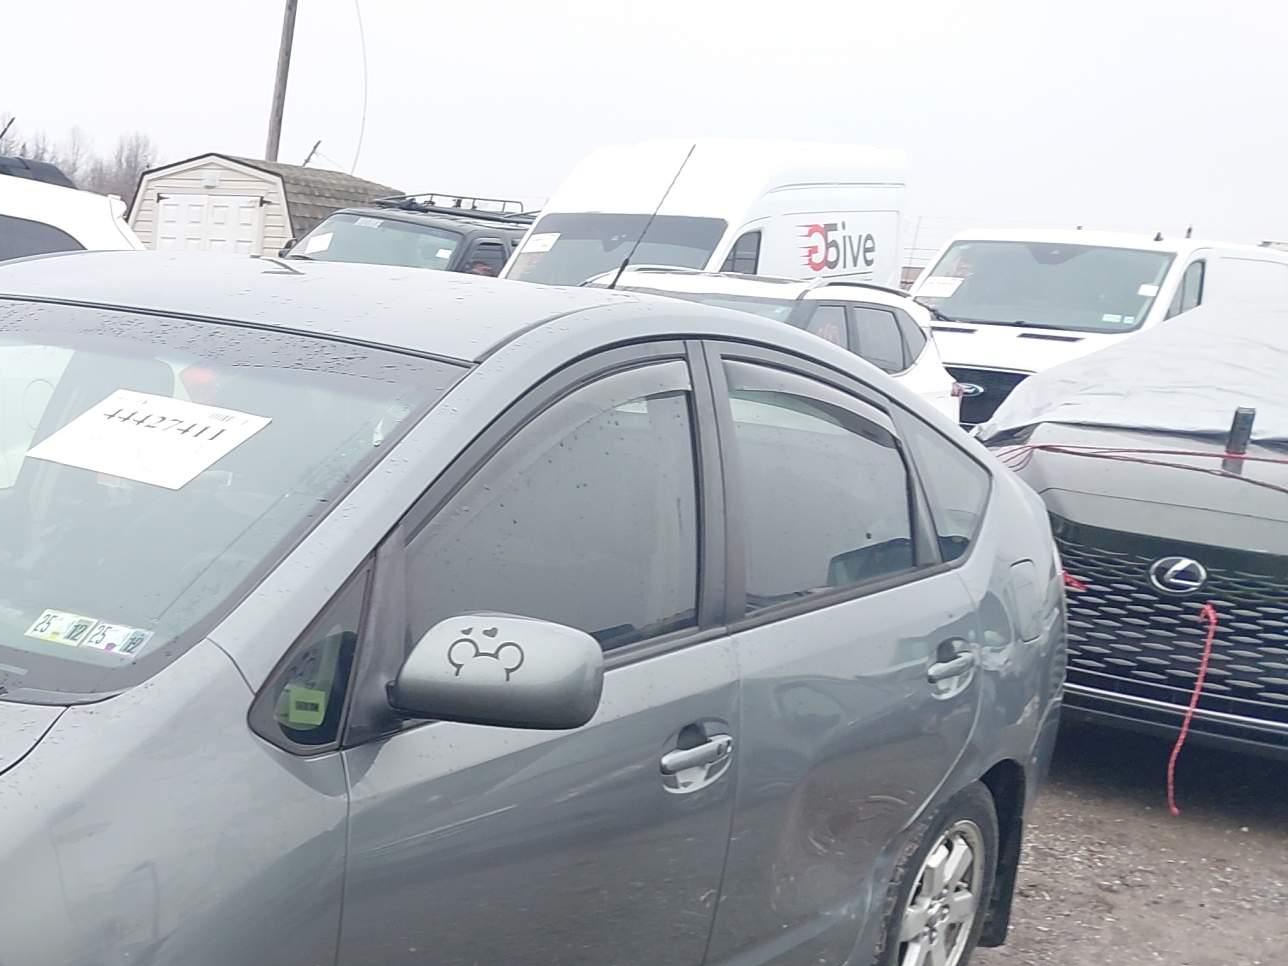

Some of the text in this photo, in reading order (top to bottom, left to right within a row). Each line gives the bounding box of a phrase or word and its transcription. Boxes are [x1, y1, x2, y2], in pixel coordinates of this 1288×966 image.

[103, 408, 227, 441] 44427411
[33, 613, 58, 632] 25
[89, 624, 112, 644] 25
